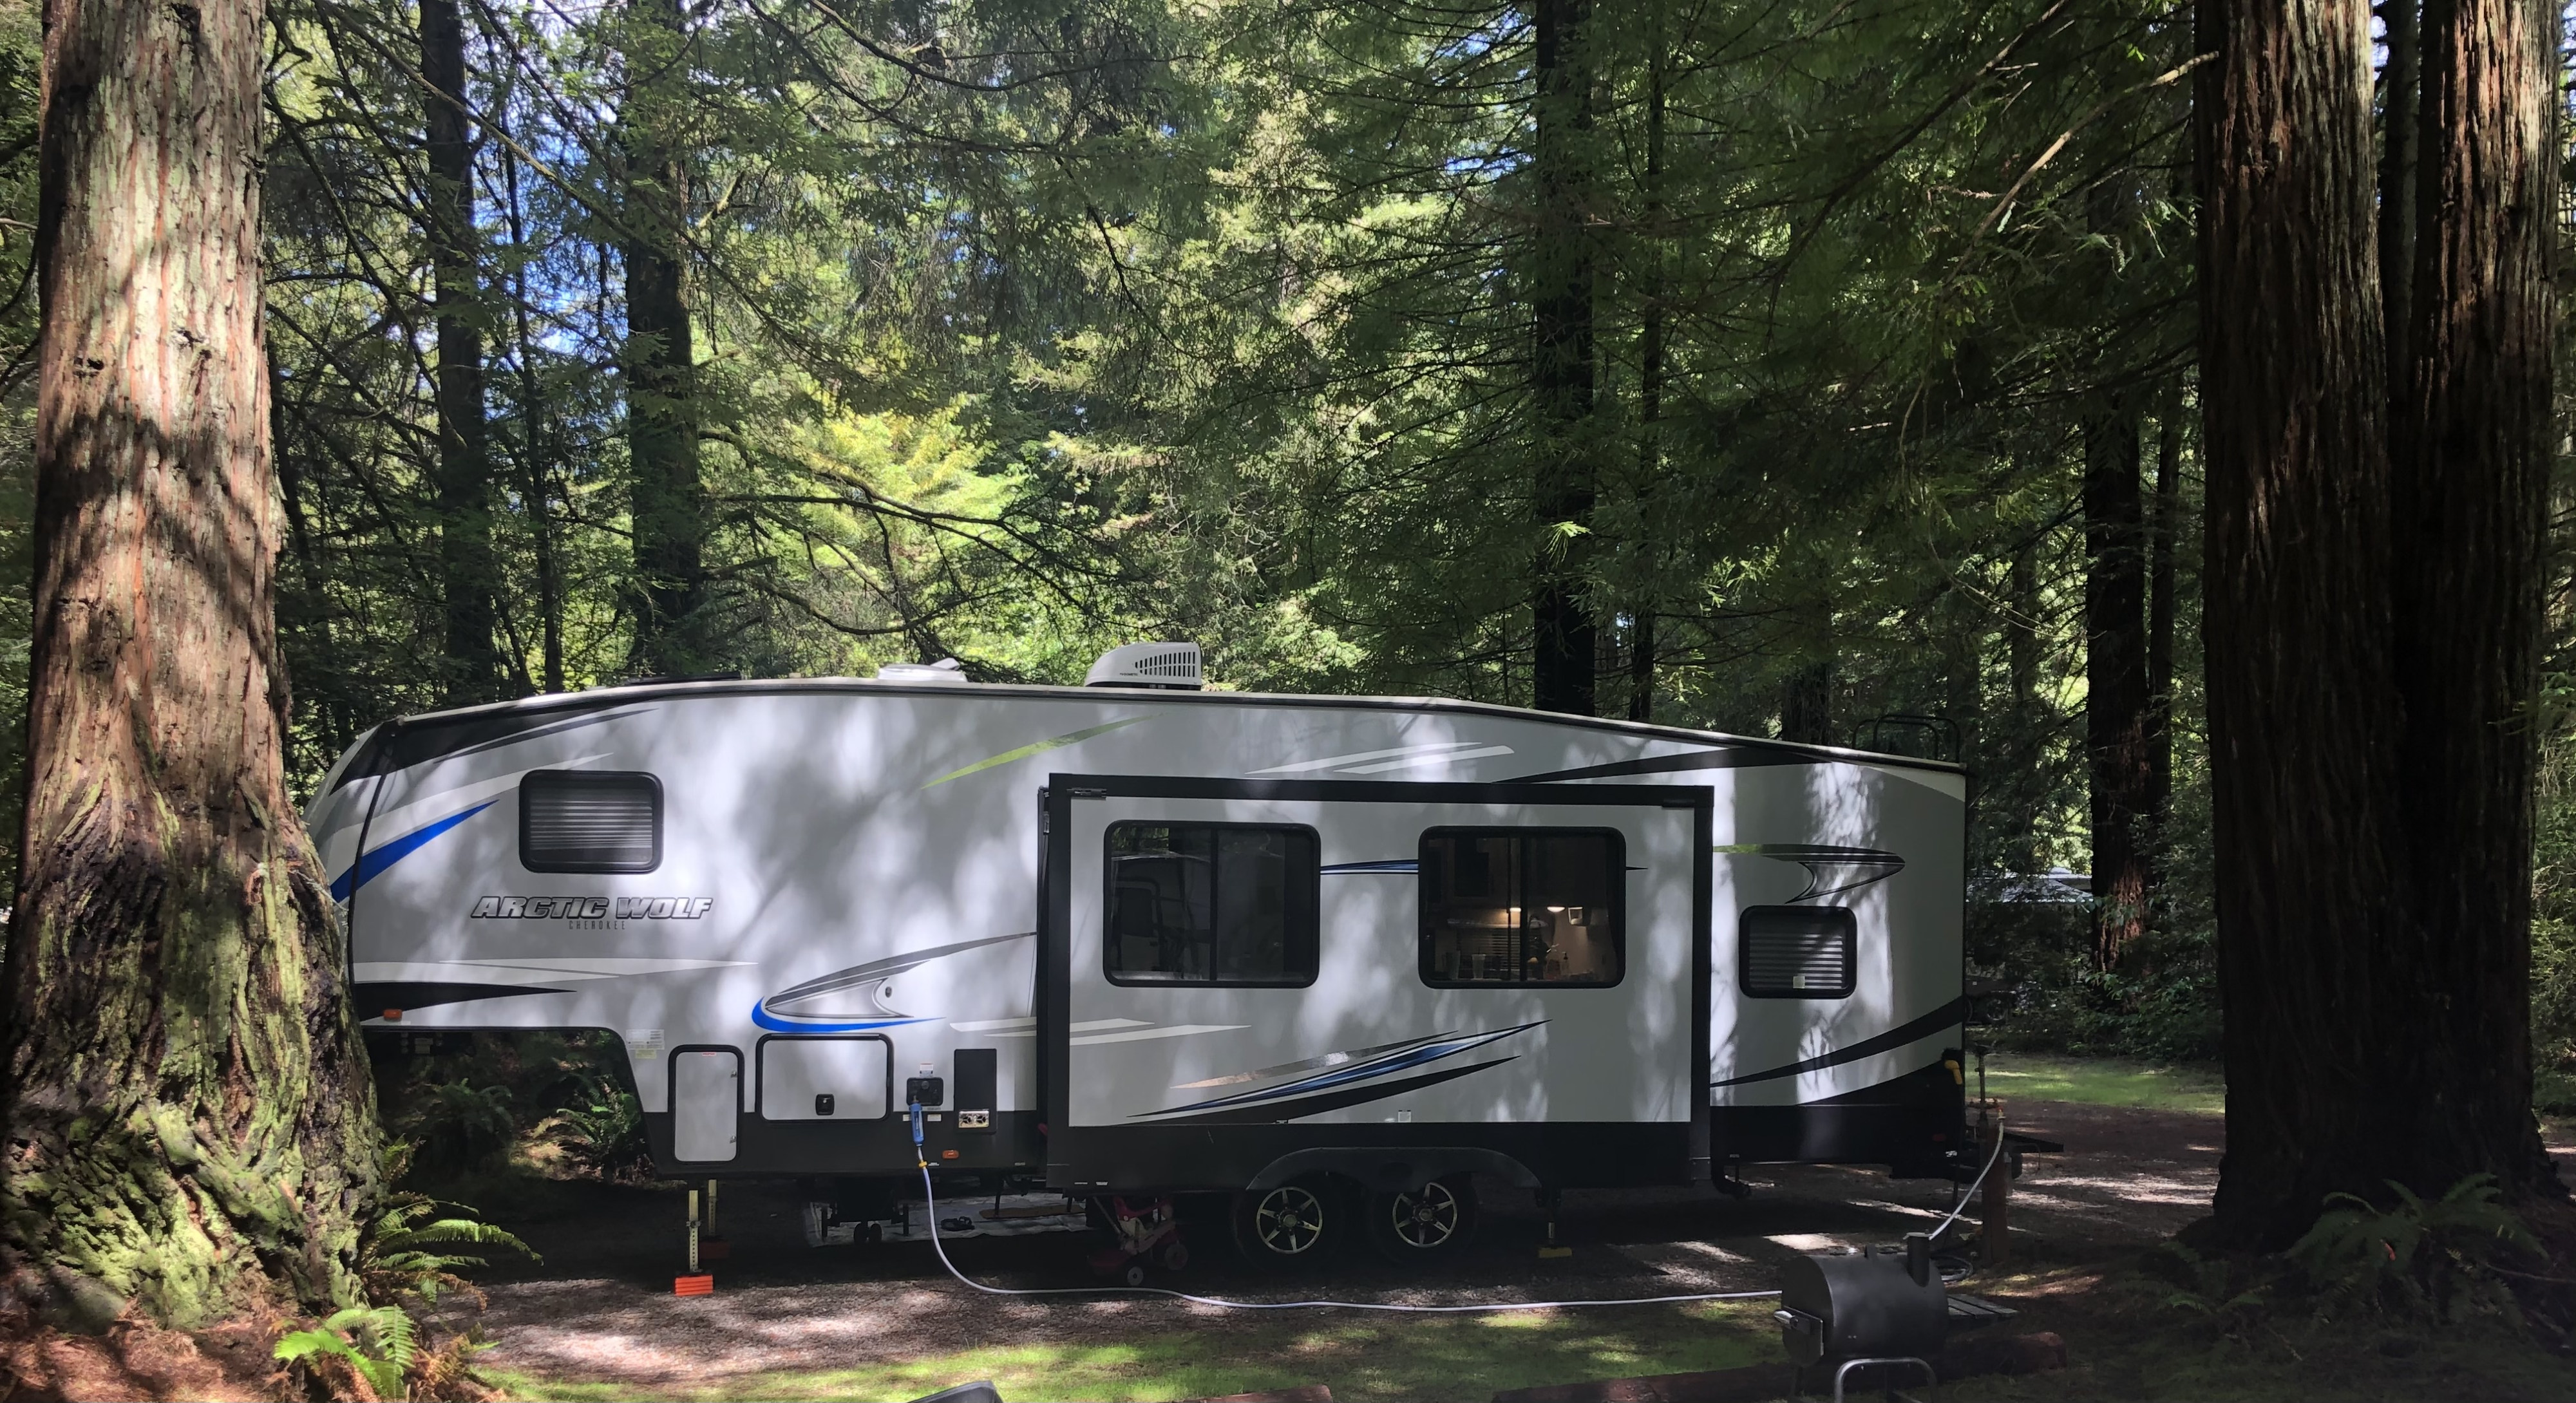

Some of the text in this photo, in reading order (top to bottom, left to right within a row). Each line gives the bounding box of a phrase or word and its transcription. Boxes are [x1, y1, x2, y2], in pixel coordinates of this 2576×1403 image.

[470, 896, 713, 919] ARCTIC WOLF
[569, 920, 625, 930] CHEROKEE
